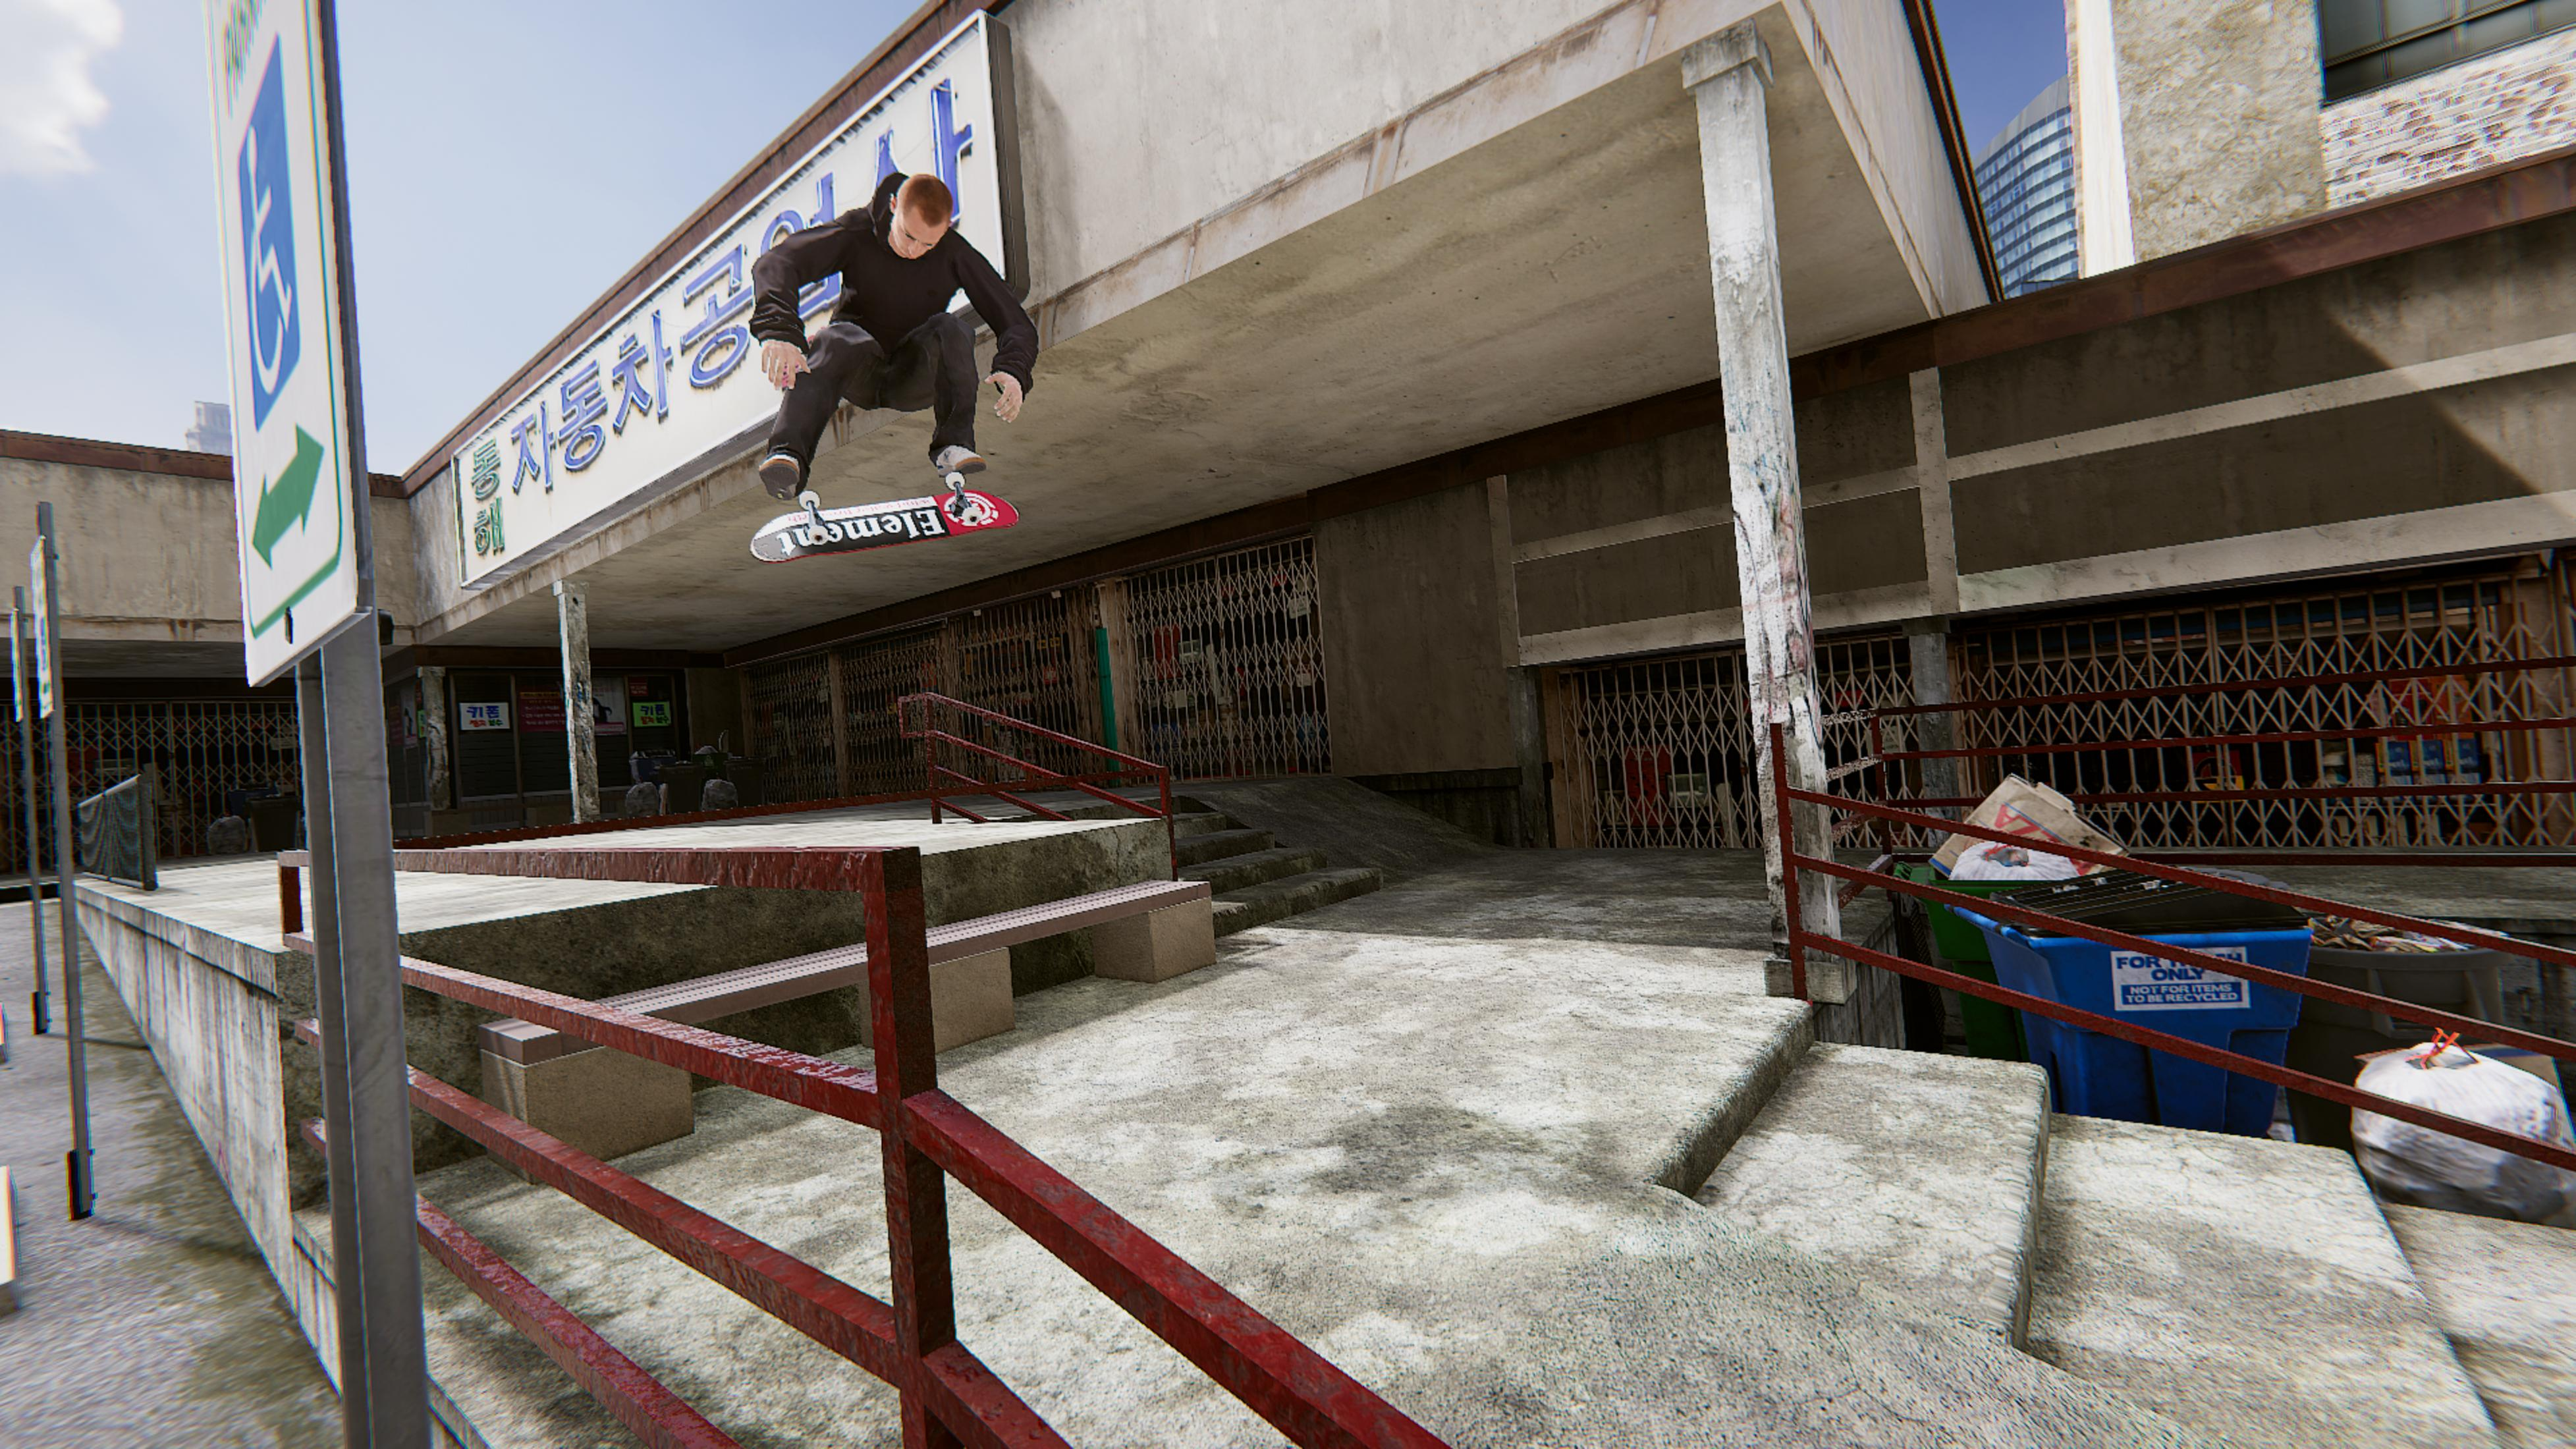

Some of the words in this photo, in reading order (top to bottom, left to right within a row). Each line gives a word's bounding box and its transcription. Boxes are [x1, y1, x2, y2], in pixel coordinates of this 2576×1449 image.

[472, 438, 505, 555] 동해
[2116, 956, 2162, 969] FOR
[2151, 968, 2205, 981] ONLY
[2130, 985, 2160, 995] NOT
[2161, 985, 2190, 994] FOR
[2192, 983, 2232, 993] ITEMS
[2125, 995, 2145, 1003] TO
[2147, 994, 2165, 1003] BE
[2166, 993, 2238, 1002] RECYCLED
